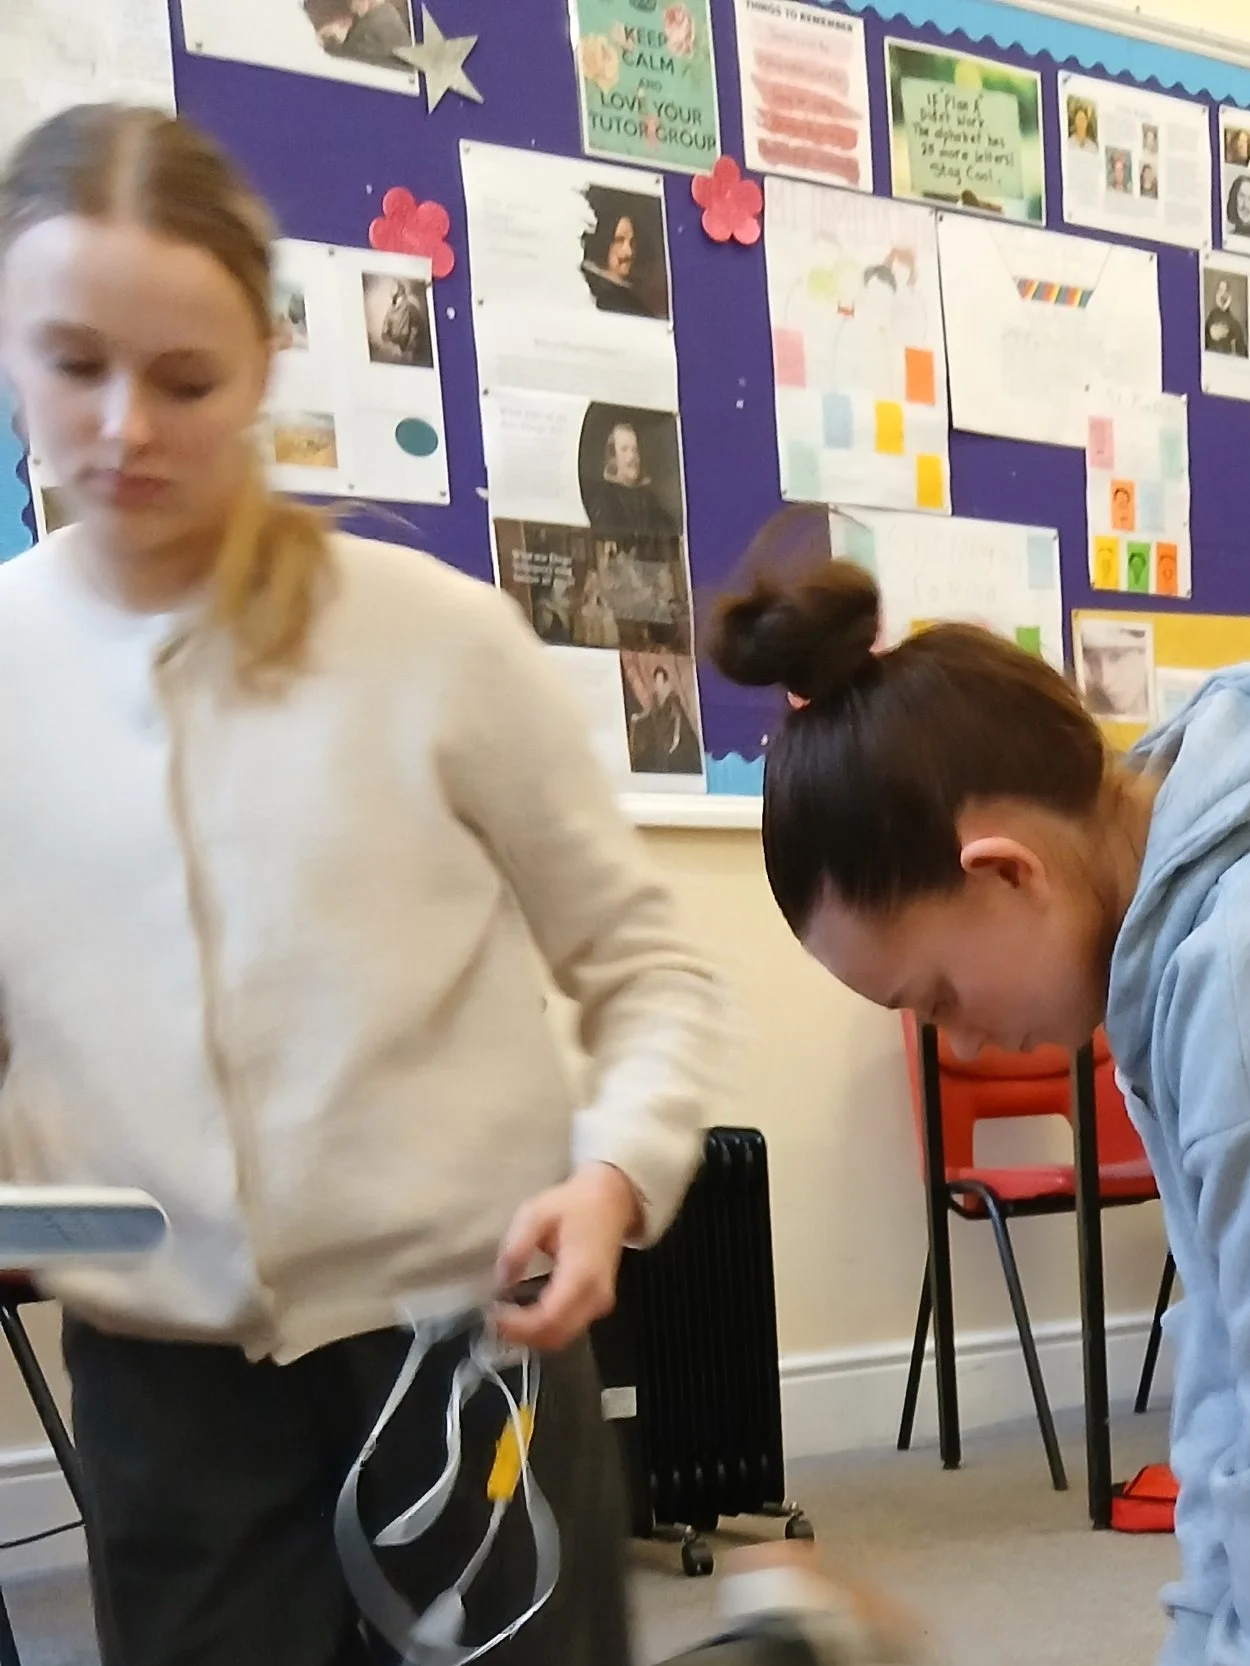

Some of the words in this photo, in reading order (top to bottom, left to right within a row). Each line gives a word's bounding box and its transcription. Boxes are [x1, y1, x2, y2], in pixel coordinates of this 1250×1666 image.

[746, 1, 782, 17] THINGS
[784, 8, 798, 21] TO
[800, 12, 853, 33] REMEMBER
[624, 25, 668, 48] KEEP
[622, 49, 675, 76] CALM
[638, 78, 663, 93] AND
[600, 91, 646, 114] LOVE
[653, 100, 702, 126] YOUR
[589, 110, 649, 140] TUTOR
[655, 125, 716, 151] GROUP
[935, 127, 982, 149] alphabet
